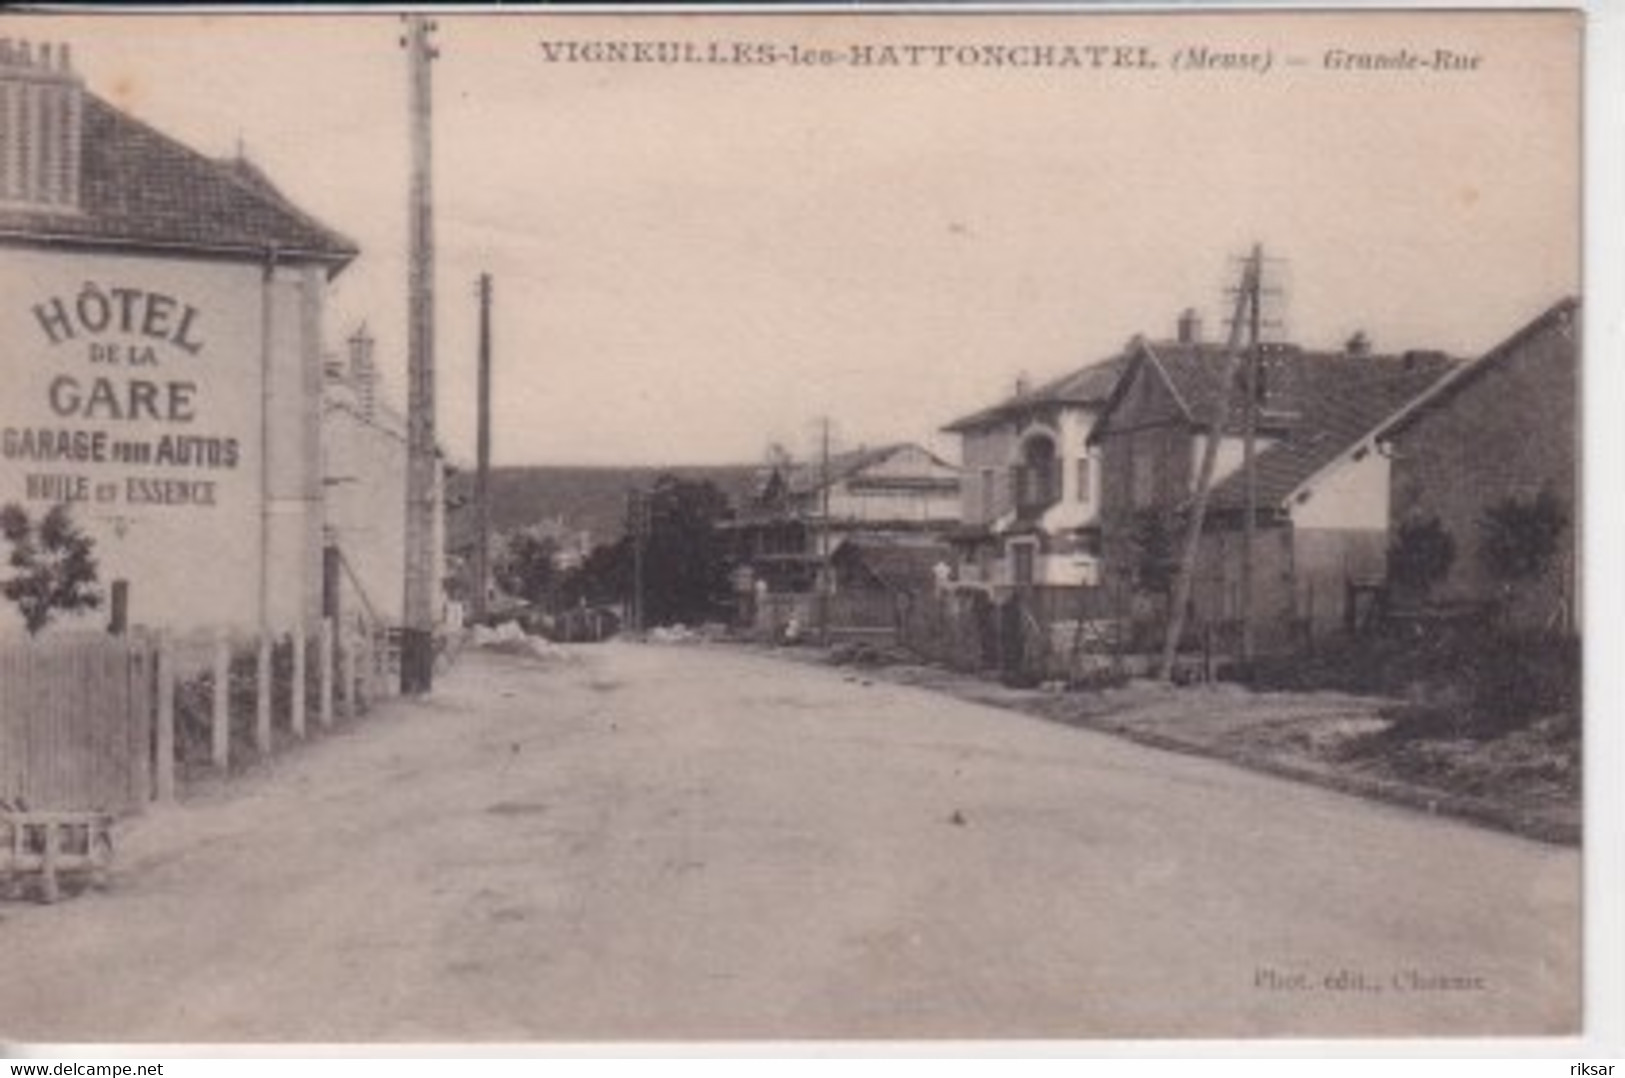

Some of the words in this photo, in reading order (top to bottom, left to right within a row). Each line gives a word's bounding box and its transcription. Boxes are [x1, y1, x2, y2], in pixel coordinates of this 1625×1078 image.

[32, 279, 205, 355] HÔTEL
[89, 343, 119, 364] DE
[128, 345, 159, 367] LA
[49, 374, 198, 422] GARE
[2, 426, 108, 463] GARAGE
[155, 434, 240, 468] AUTOS
[25, 473, 89, 502] HUILE
[126, 476, 217, 506] ESSENCE
